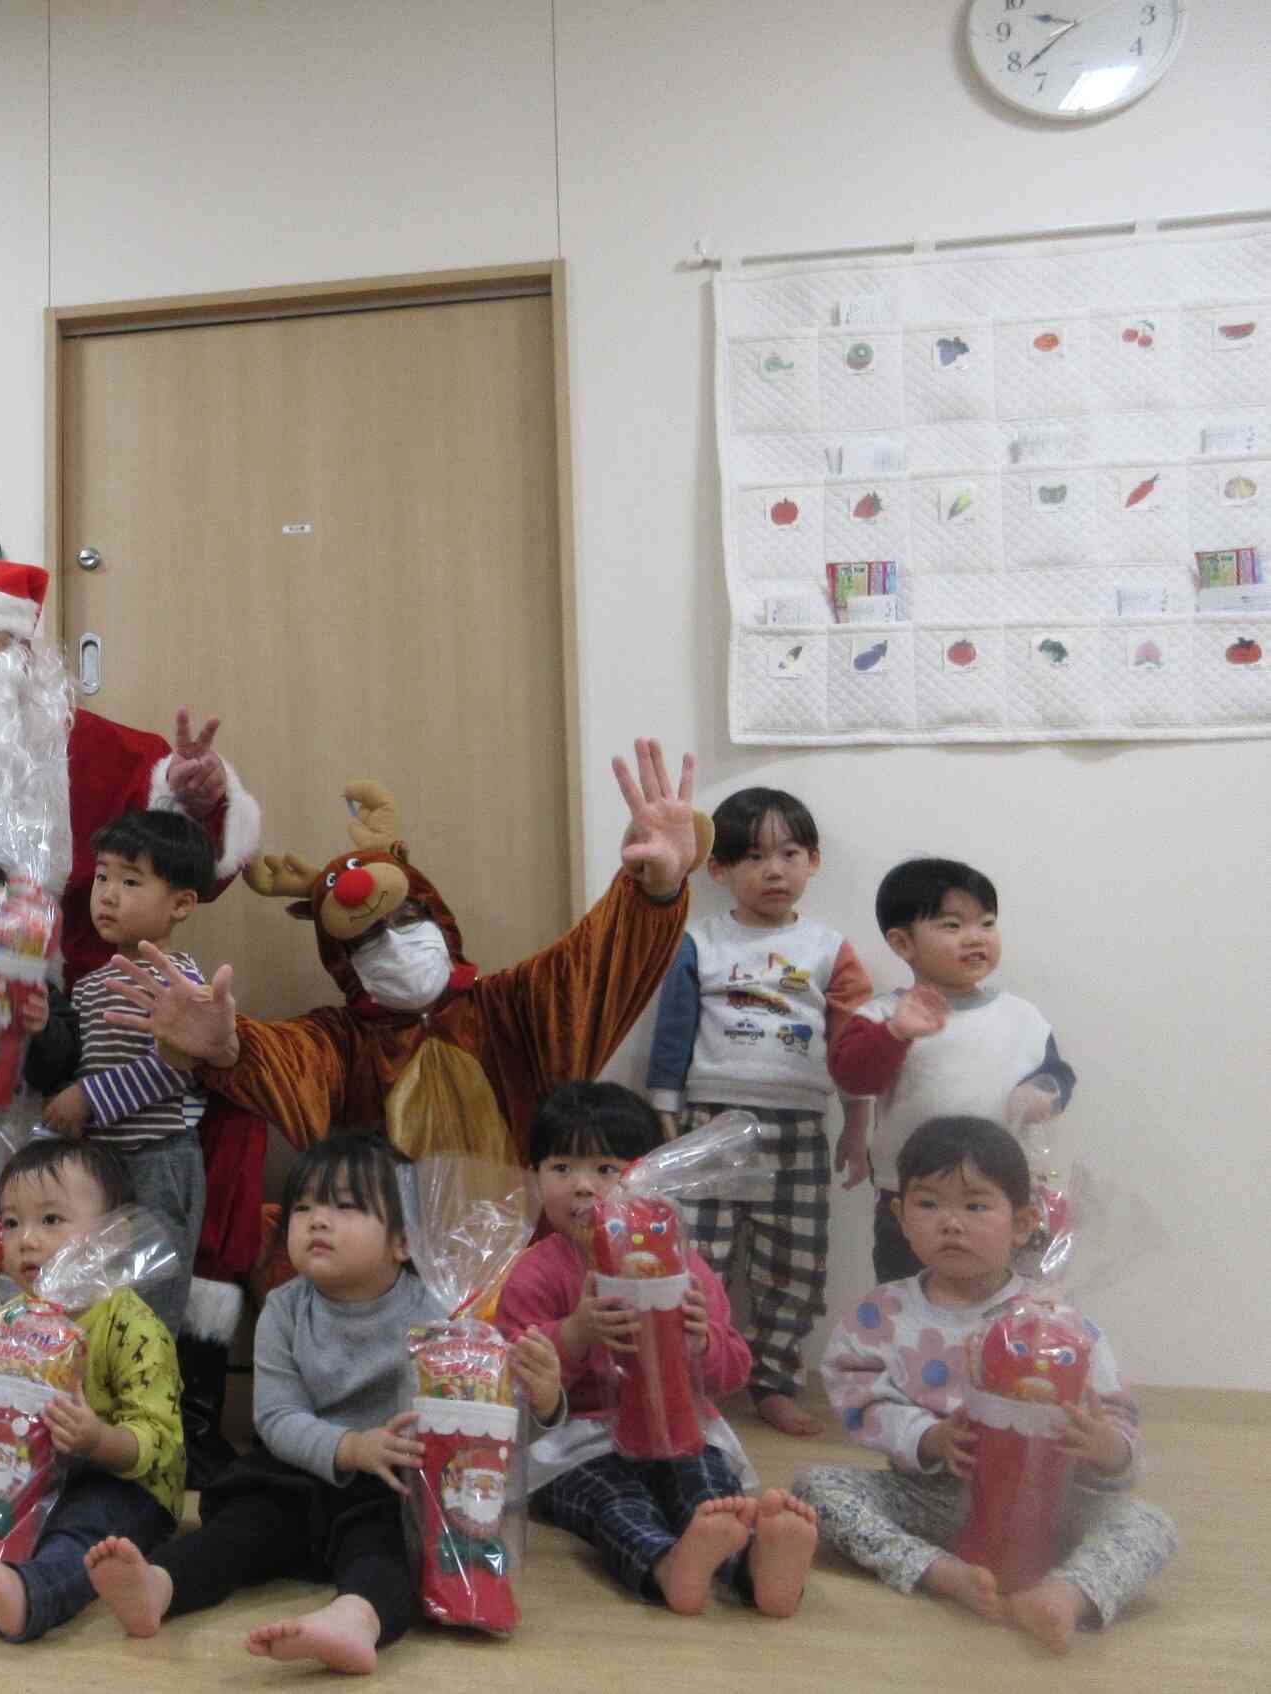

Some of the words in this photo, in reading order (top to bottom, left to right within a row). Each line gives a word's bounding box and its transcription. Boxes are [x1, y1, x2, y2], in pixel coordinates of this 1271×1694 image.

[1141, 4, 1156, 26] 3
[995, 21, 1012, 43] 9
[1129, 36, 1144, 57] 4
[1006, 50, 1023, 73] 8
[1033, 71, 1048, 93] 7
